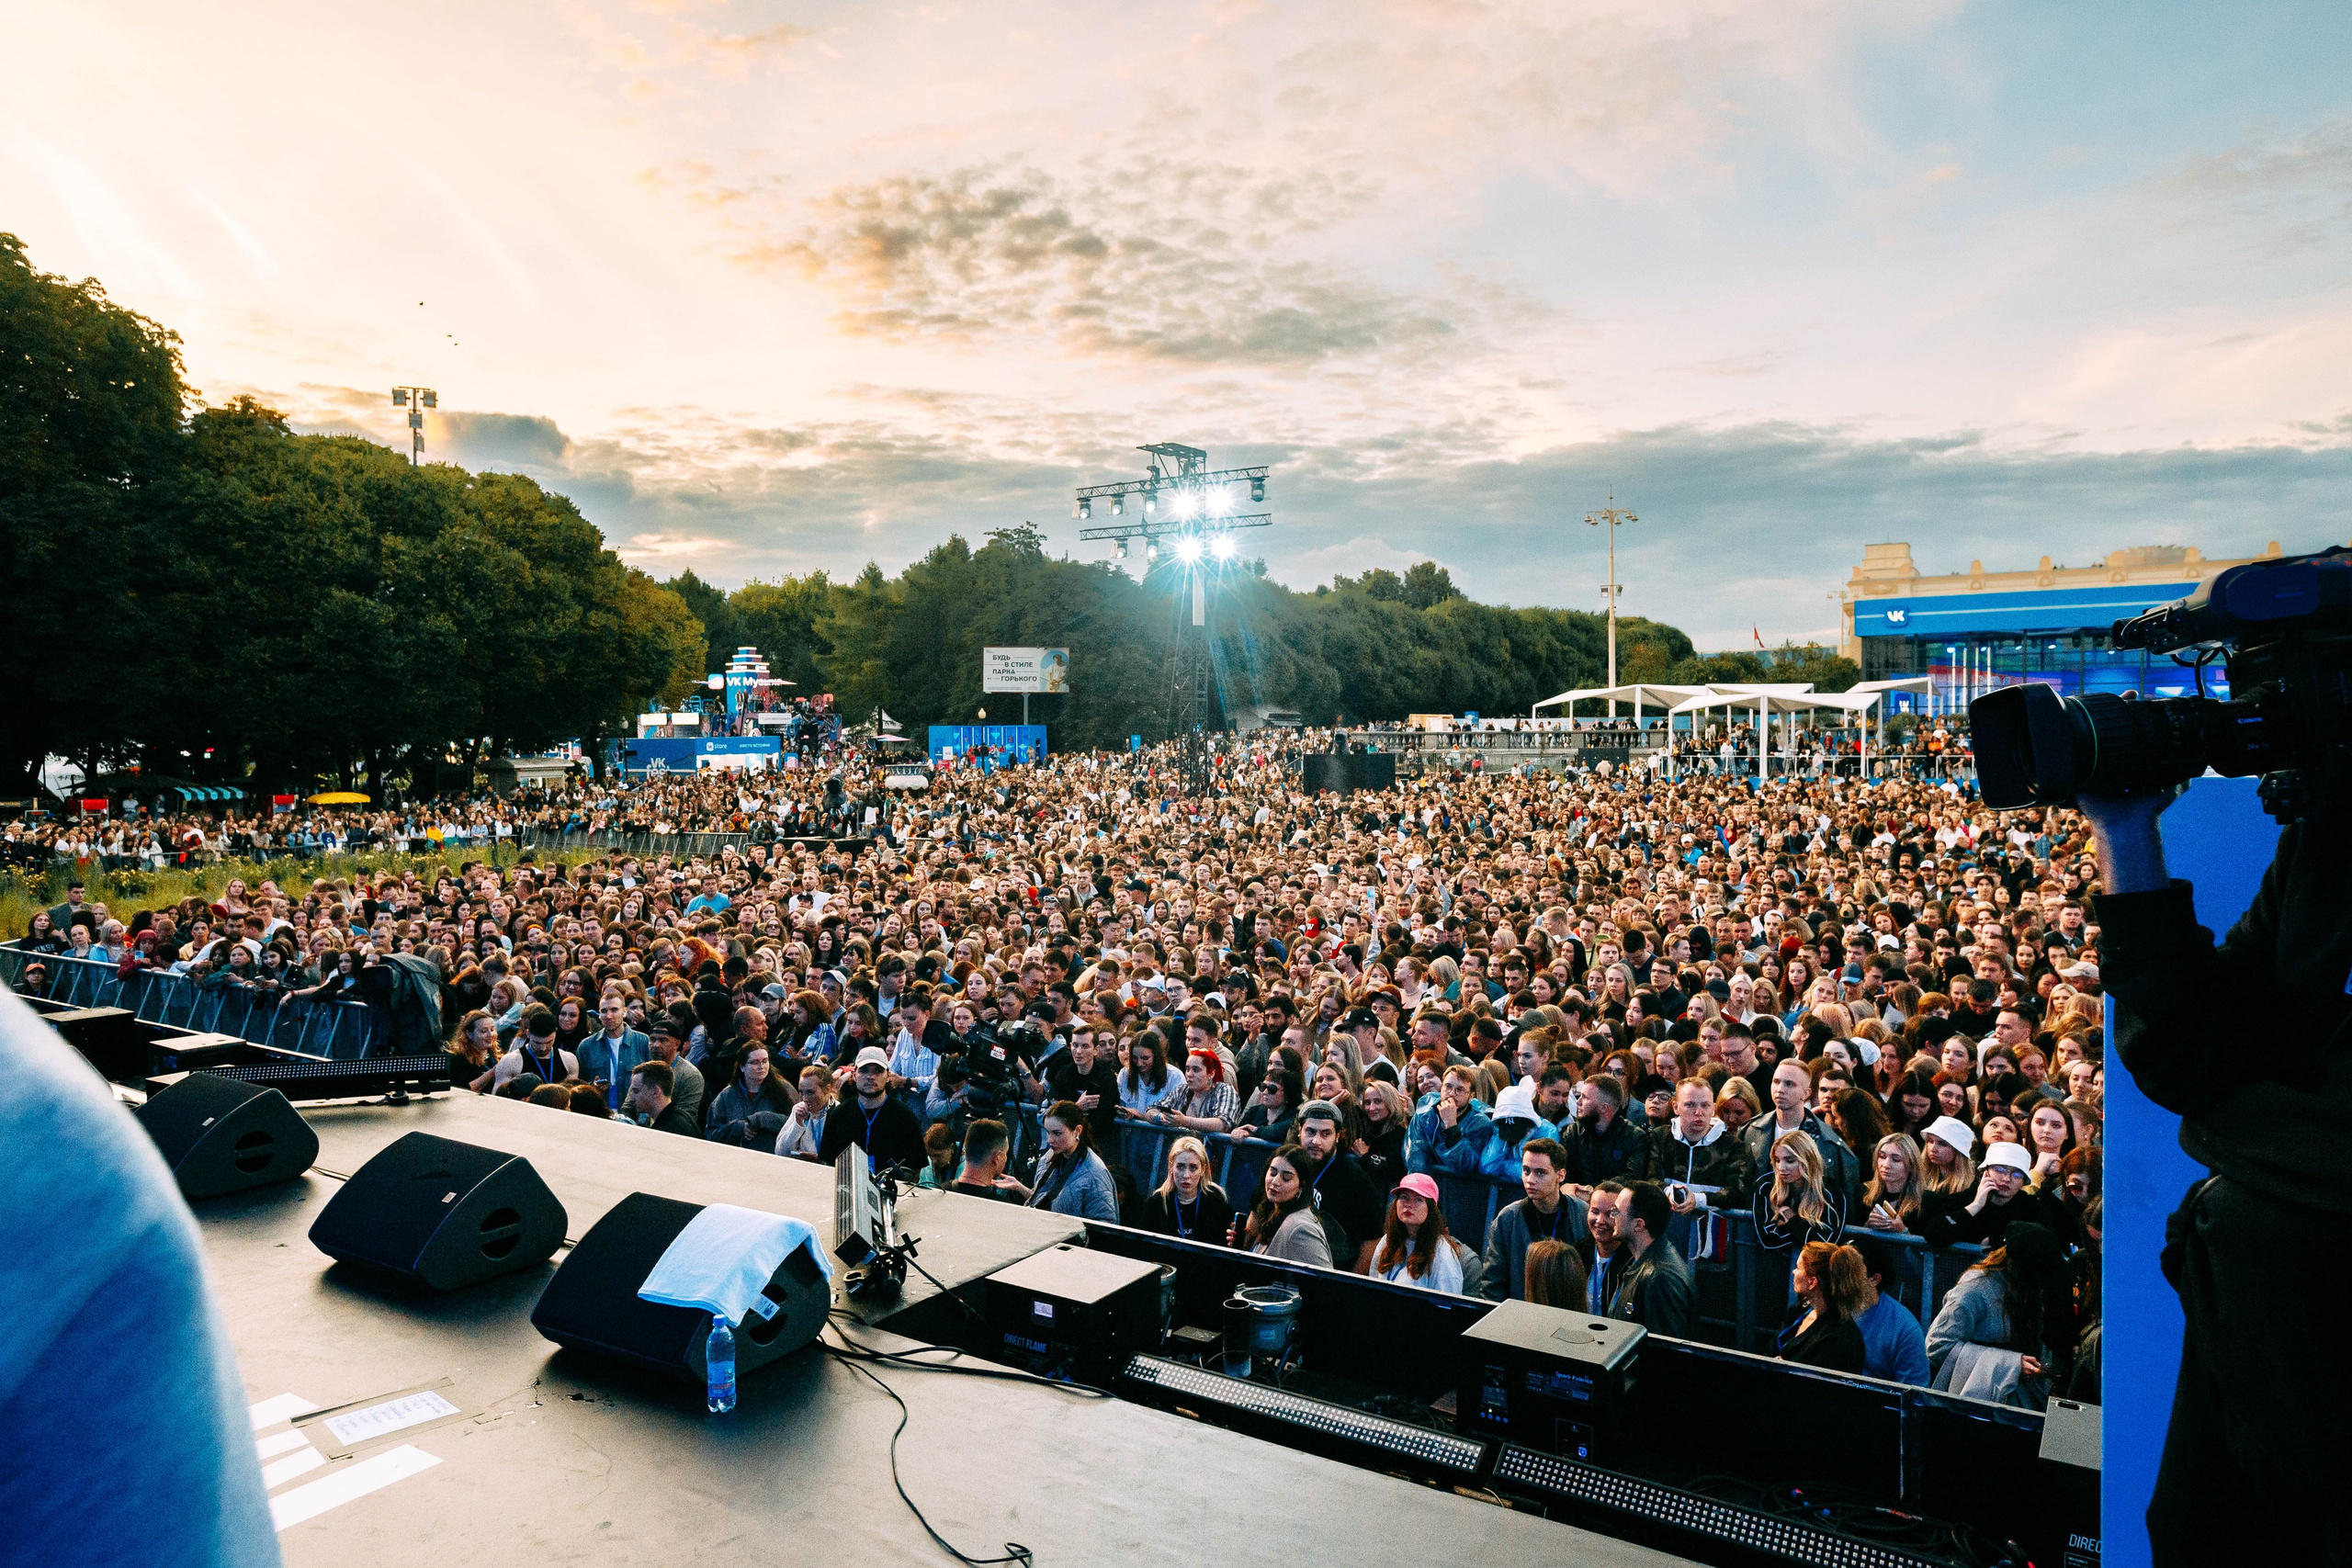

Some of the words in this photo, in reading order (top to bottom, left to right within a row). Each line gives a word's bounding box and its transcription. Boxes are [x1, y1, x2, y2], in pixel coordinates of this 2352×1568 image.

[1887, 610, 1905, 622] VK
[726, 676, 741, 686] VK
[650, 758, 666, 768] VK
[1003, 1333, 1026, 1348] DIRECT
[1025, 1338, 1047, 1354] FLAME
[1555, 1371, 1571, 1381] Spark
[1571, 1375, 1593, 1385] Fabrika
